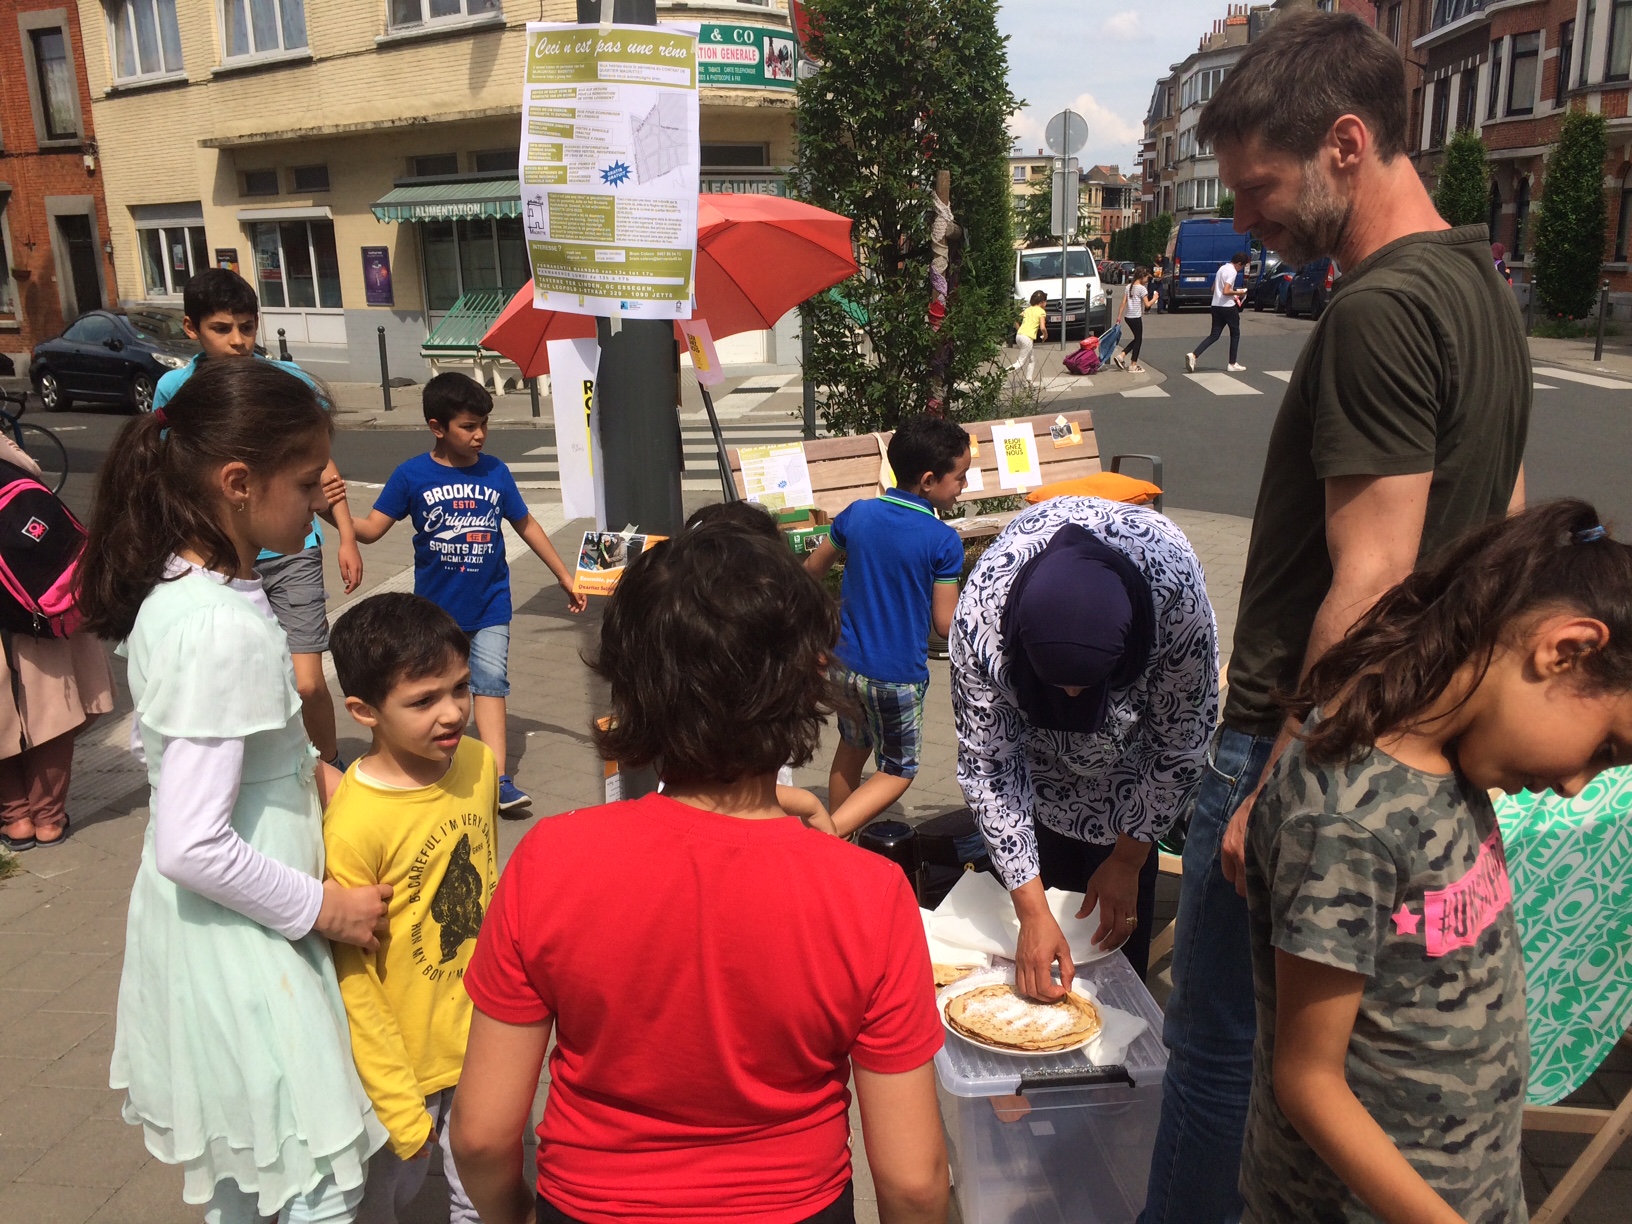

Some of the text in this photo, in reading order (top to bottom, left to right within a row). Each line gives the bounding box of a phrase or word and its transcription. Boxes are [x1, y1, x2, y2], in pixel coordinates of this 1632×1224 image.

[711, 28, 754, 43] & CO
[535, 35, 688, 59] Ceci n'est pas une réno
[720, 48, 756, 61] GENERALE
[702, 182, 778, 195] LEGUMES
[415, 203, 480, 217] ALIMENTATION
[423, 484, 500, 506] BROOKLYN
[453, 500, 478, 509] ESTD.
[423, 506, 497, 533] Originals
[429, 540, 495, 554] SPORTS DEPT.
[408, 834, 441, 889] CAREFUL
[440, 819, 459, 837] I'M
[461, 813, 483, 828] VERY
[412, 922, 422, 945] RUN
[412, 946, 428, 965] MY
[422, 964, 445, 982] BOY
